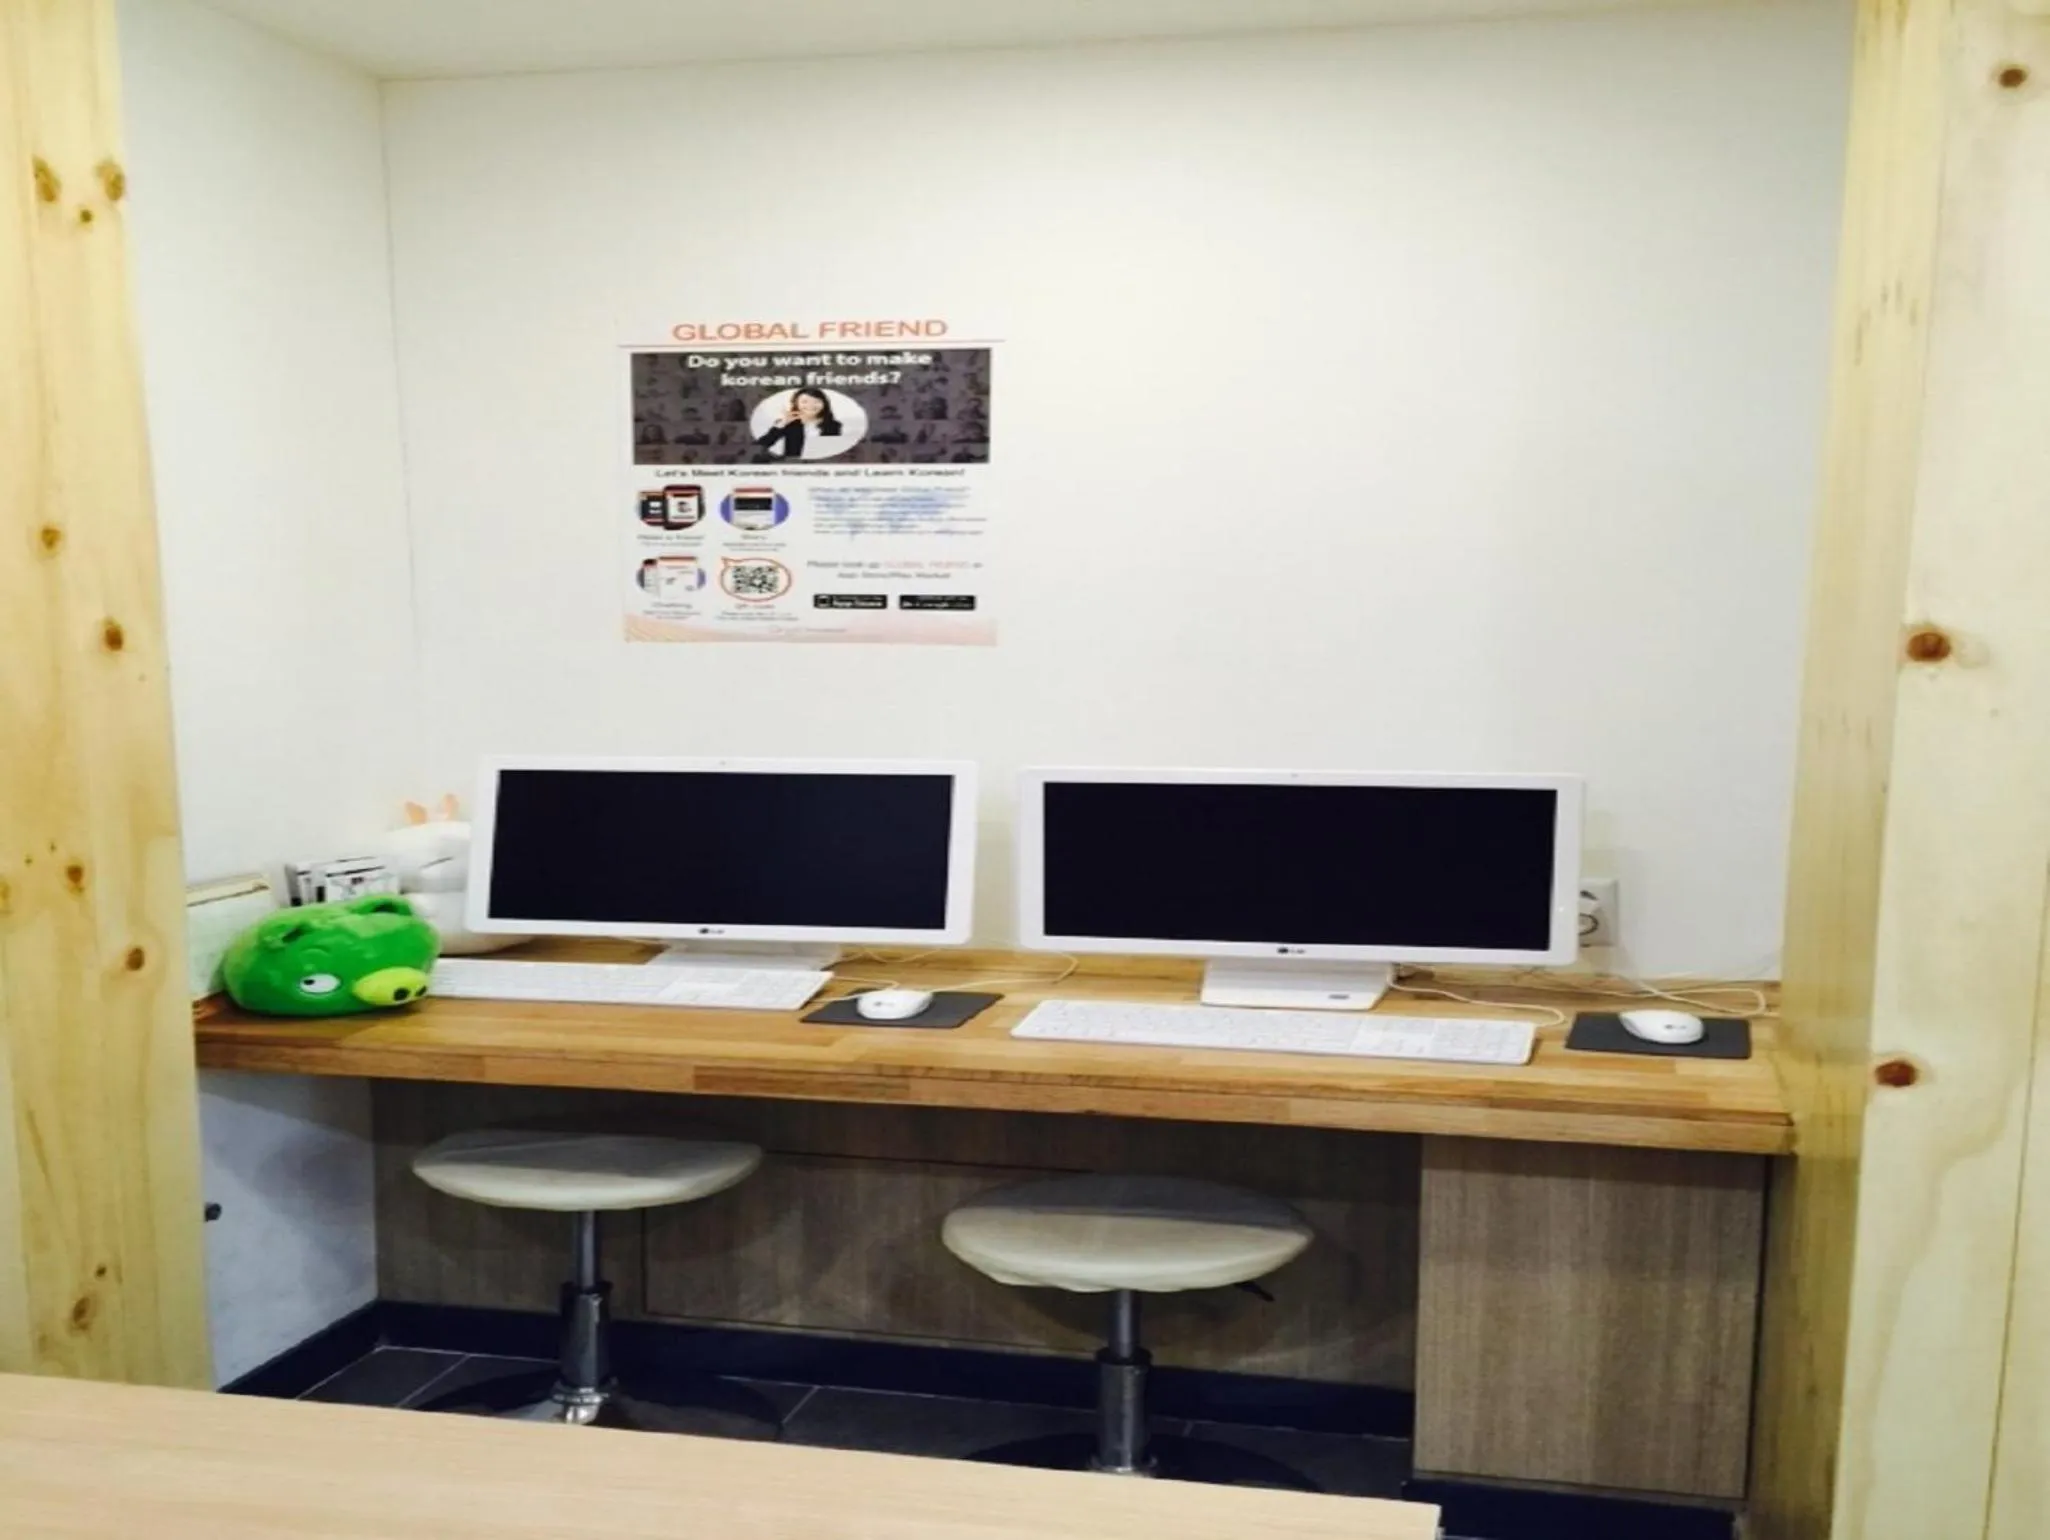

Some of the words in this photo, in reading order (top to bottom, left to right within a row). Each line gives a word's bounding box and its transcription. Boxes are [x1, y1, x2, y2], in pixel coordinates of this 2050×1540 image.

[672, 322, 809, 341] GLOBAL
[818, 319, 949, 339] FRIEND
[687, 354, 720, 368] Do
[724, 355, 768, 371] you
[772, 353, 832, 367] want
[836, 352, 863, 366] to
[866, 350, 933, 365] make
[720, 373, 801, 387] korean
[805, 371, 902, 386] friends?
